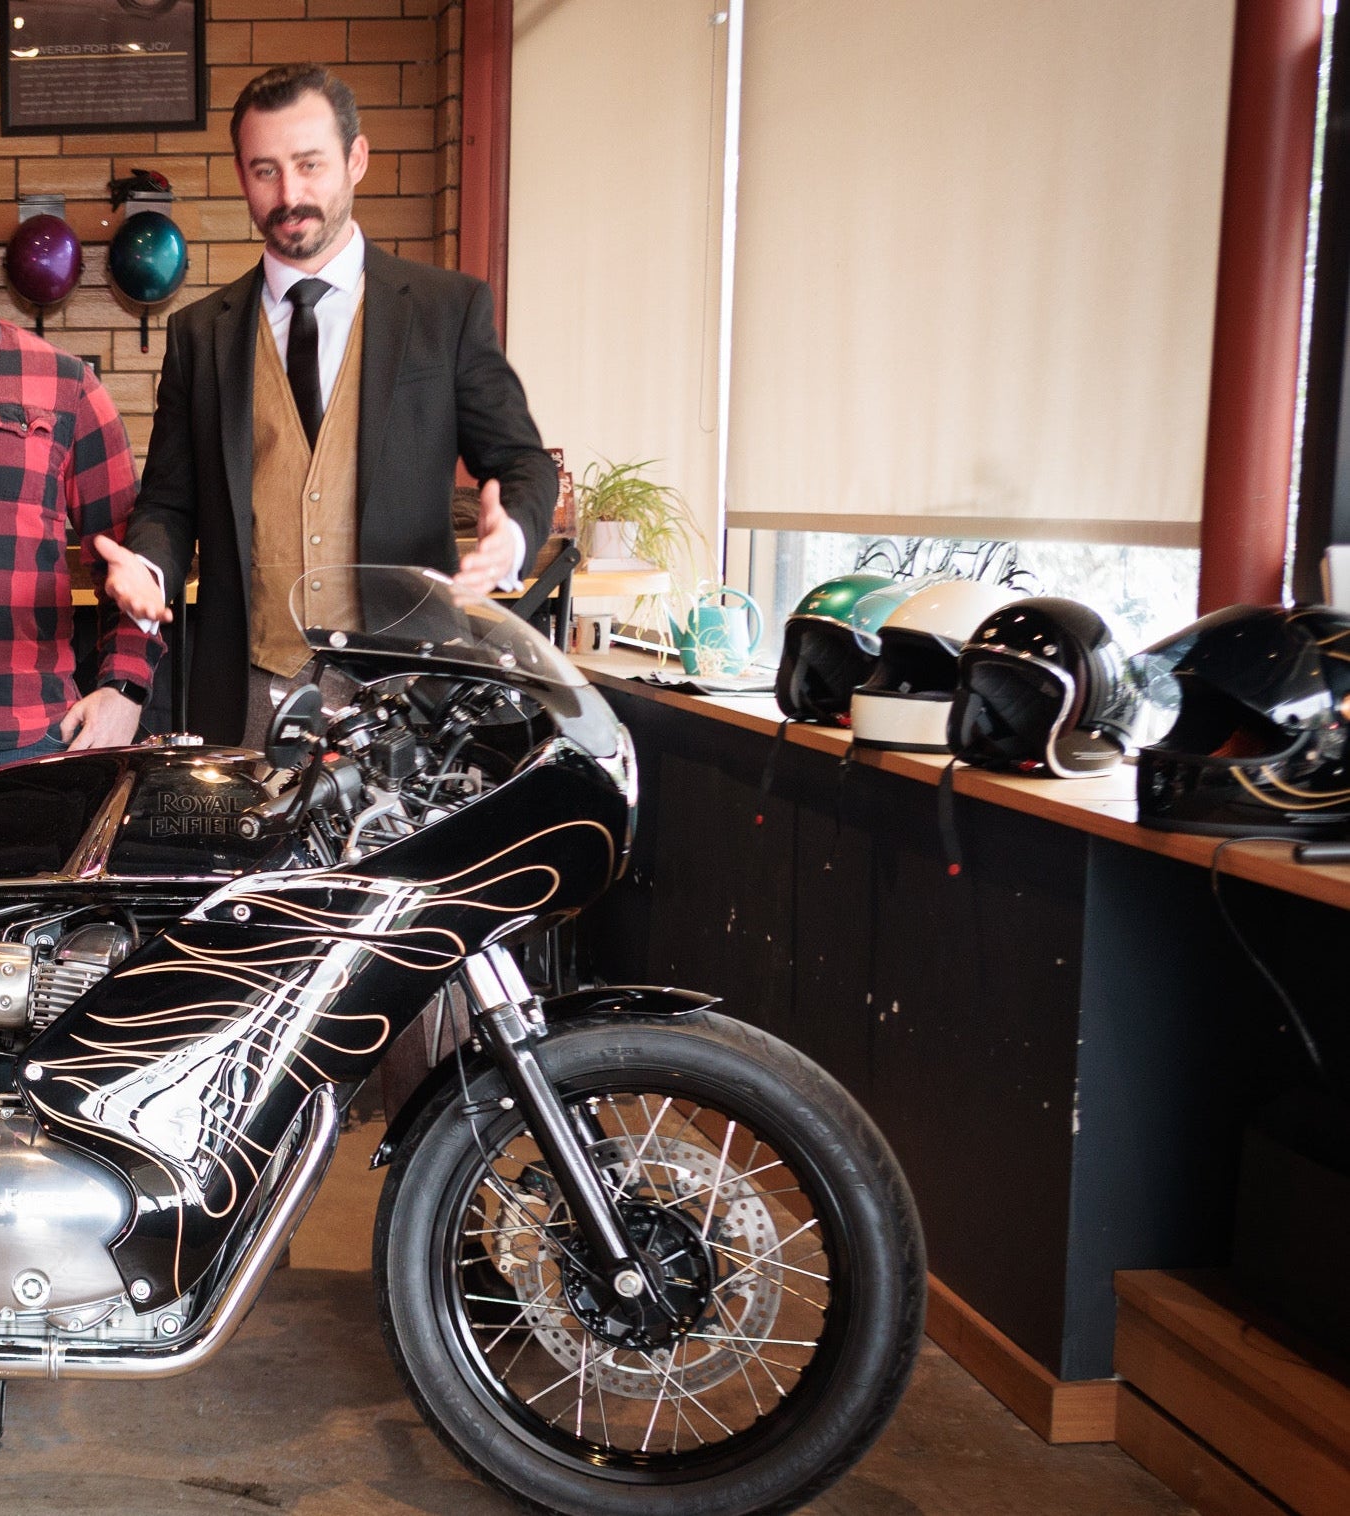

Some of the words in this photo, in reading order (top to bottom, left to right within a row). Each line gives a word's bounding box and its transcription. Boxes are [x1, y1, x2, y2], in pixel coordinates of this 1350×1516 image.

[19, 44, 82, 56] PWERED
[83, 43, 109, 54] FOR
[111, 42, 145, 53] PUE
[147, 41, 172, 51] JOY
[158, 791, 242, 815] ROYAL
[150, 816, 240, 838] ENFIEL
